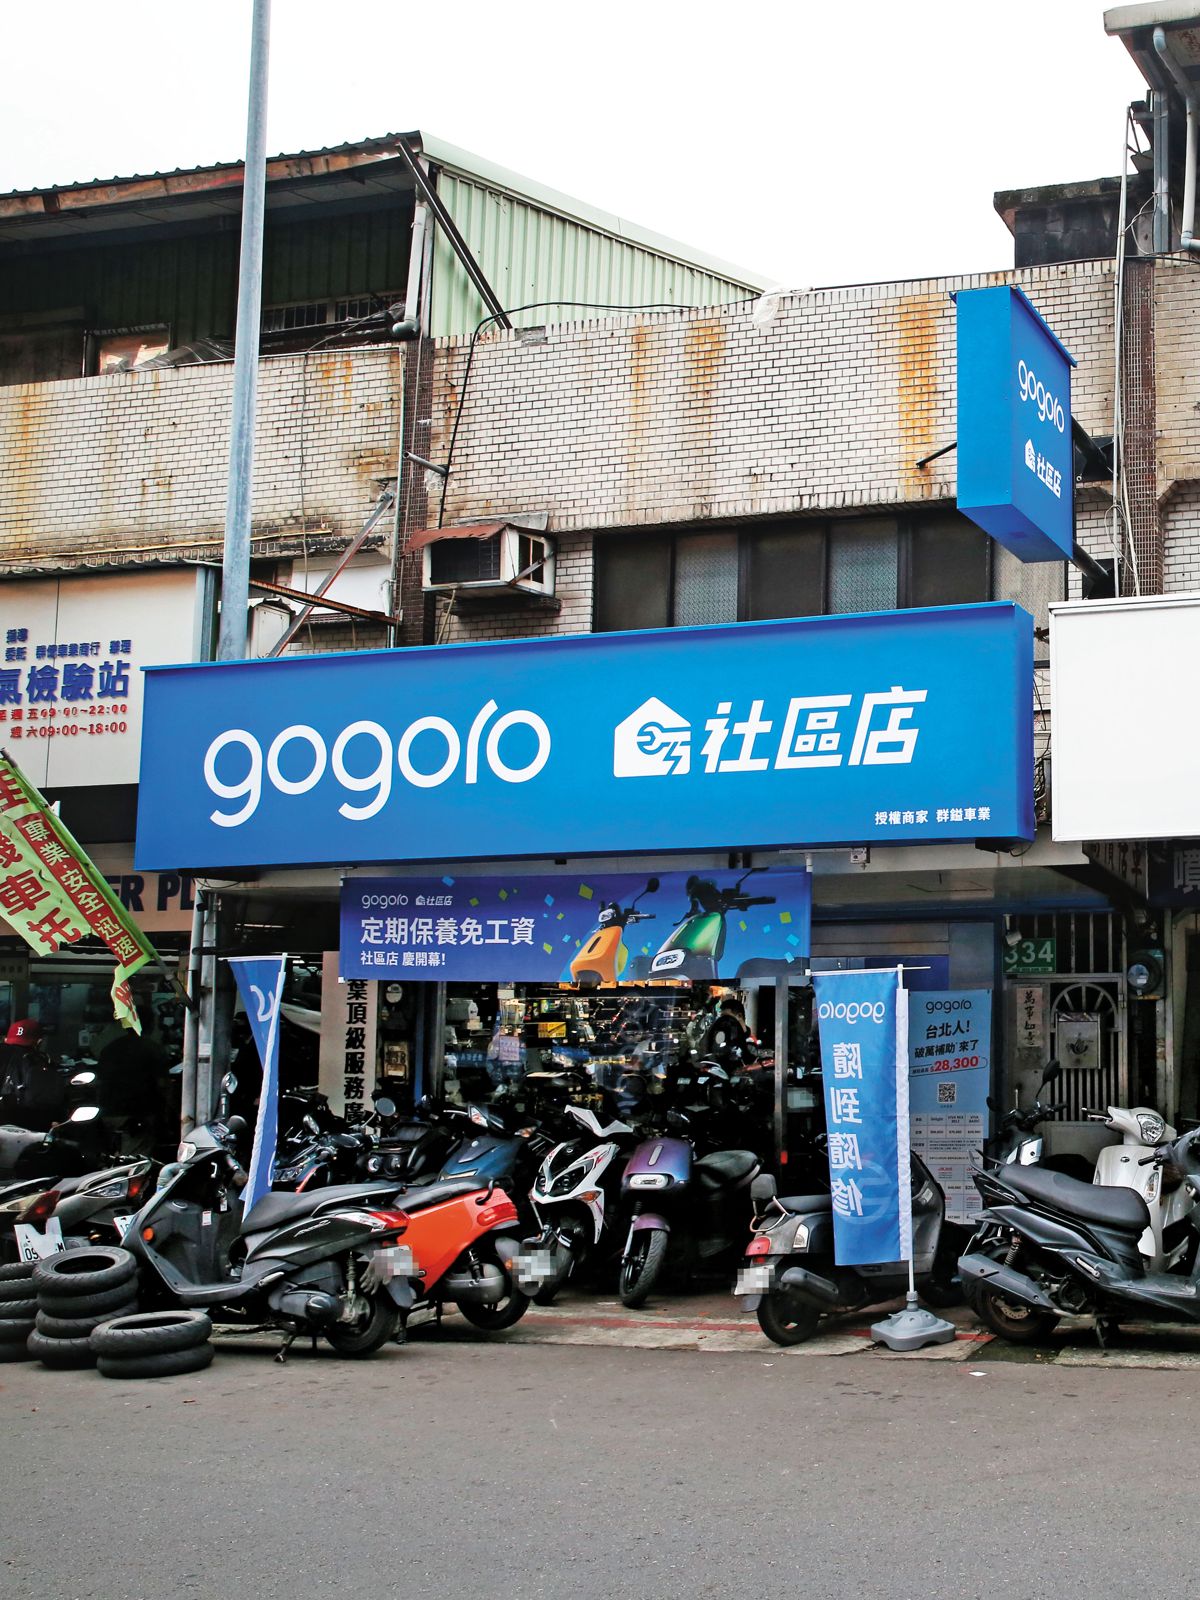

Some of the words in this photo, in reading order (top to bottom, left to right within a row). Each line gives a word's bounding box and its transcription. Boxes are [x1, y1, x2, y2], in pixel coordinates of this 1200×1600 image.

[1018, 359, 1064, 433] gogoro
[1036, 452, 1062, 499] 社區店
[700, 685, 928, 774] 社區店
[204, 698, 551, 828] gogoro
[875, 810, 928, 825] 授權商家
[361, 895, 409, 909] gogoro
[360, 917, 535, 945] 定期保養免工資
[360, 951, 399, 966] 社區店
[1004, 941, 1054, 964] 334
[925, 999, 972, 1014] gogoro
[15, 1026, 24, 1036] B
[926, 1020, 970, 1040] 台北人!
